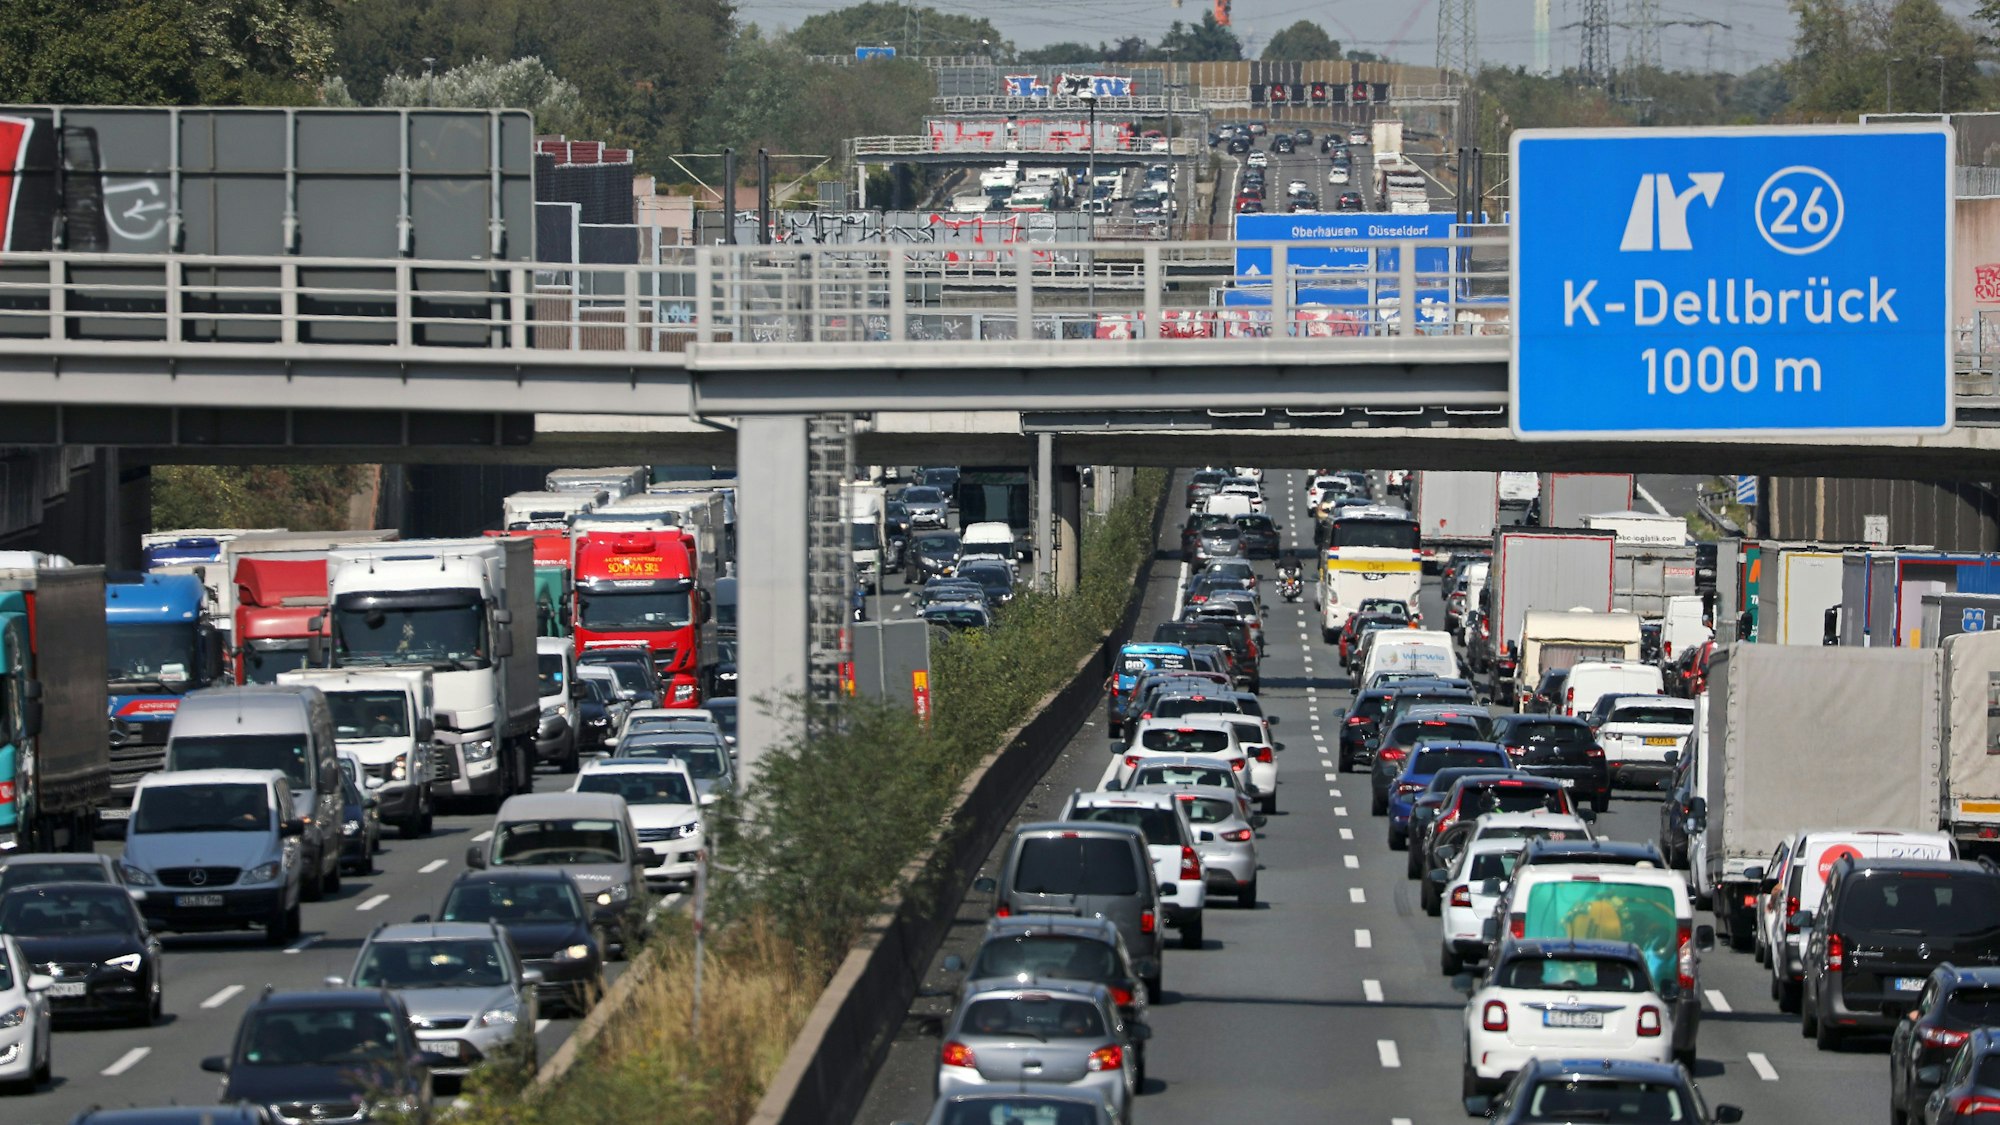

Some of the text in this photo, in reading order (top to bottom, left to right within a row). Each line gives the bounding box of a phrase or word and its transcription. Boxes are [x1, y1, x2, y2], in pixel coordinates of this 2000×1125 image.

[1770, 187, 1828, 233] 26
[1291, 224, 1429, 238] Oberhausen Düsseldorf
[1563, 276, 1899, 326] K-Dellbrück
[1641, 346, 1822, 395] 1000 m
[608, 562, 643, 573] SOMMA
[1125, 660, 1144, 670] pm
